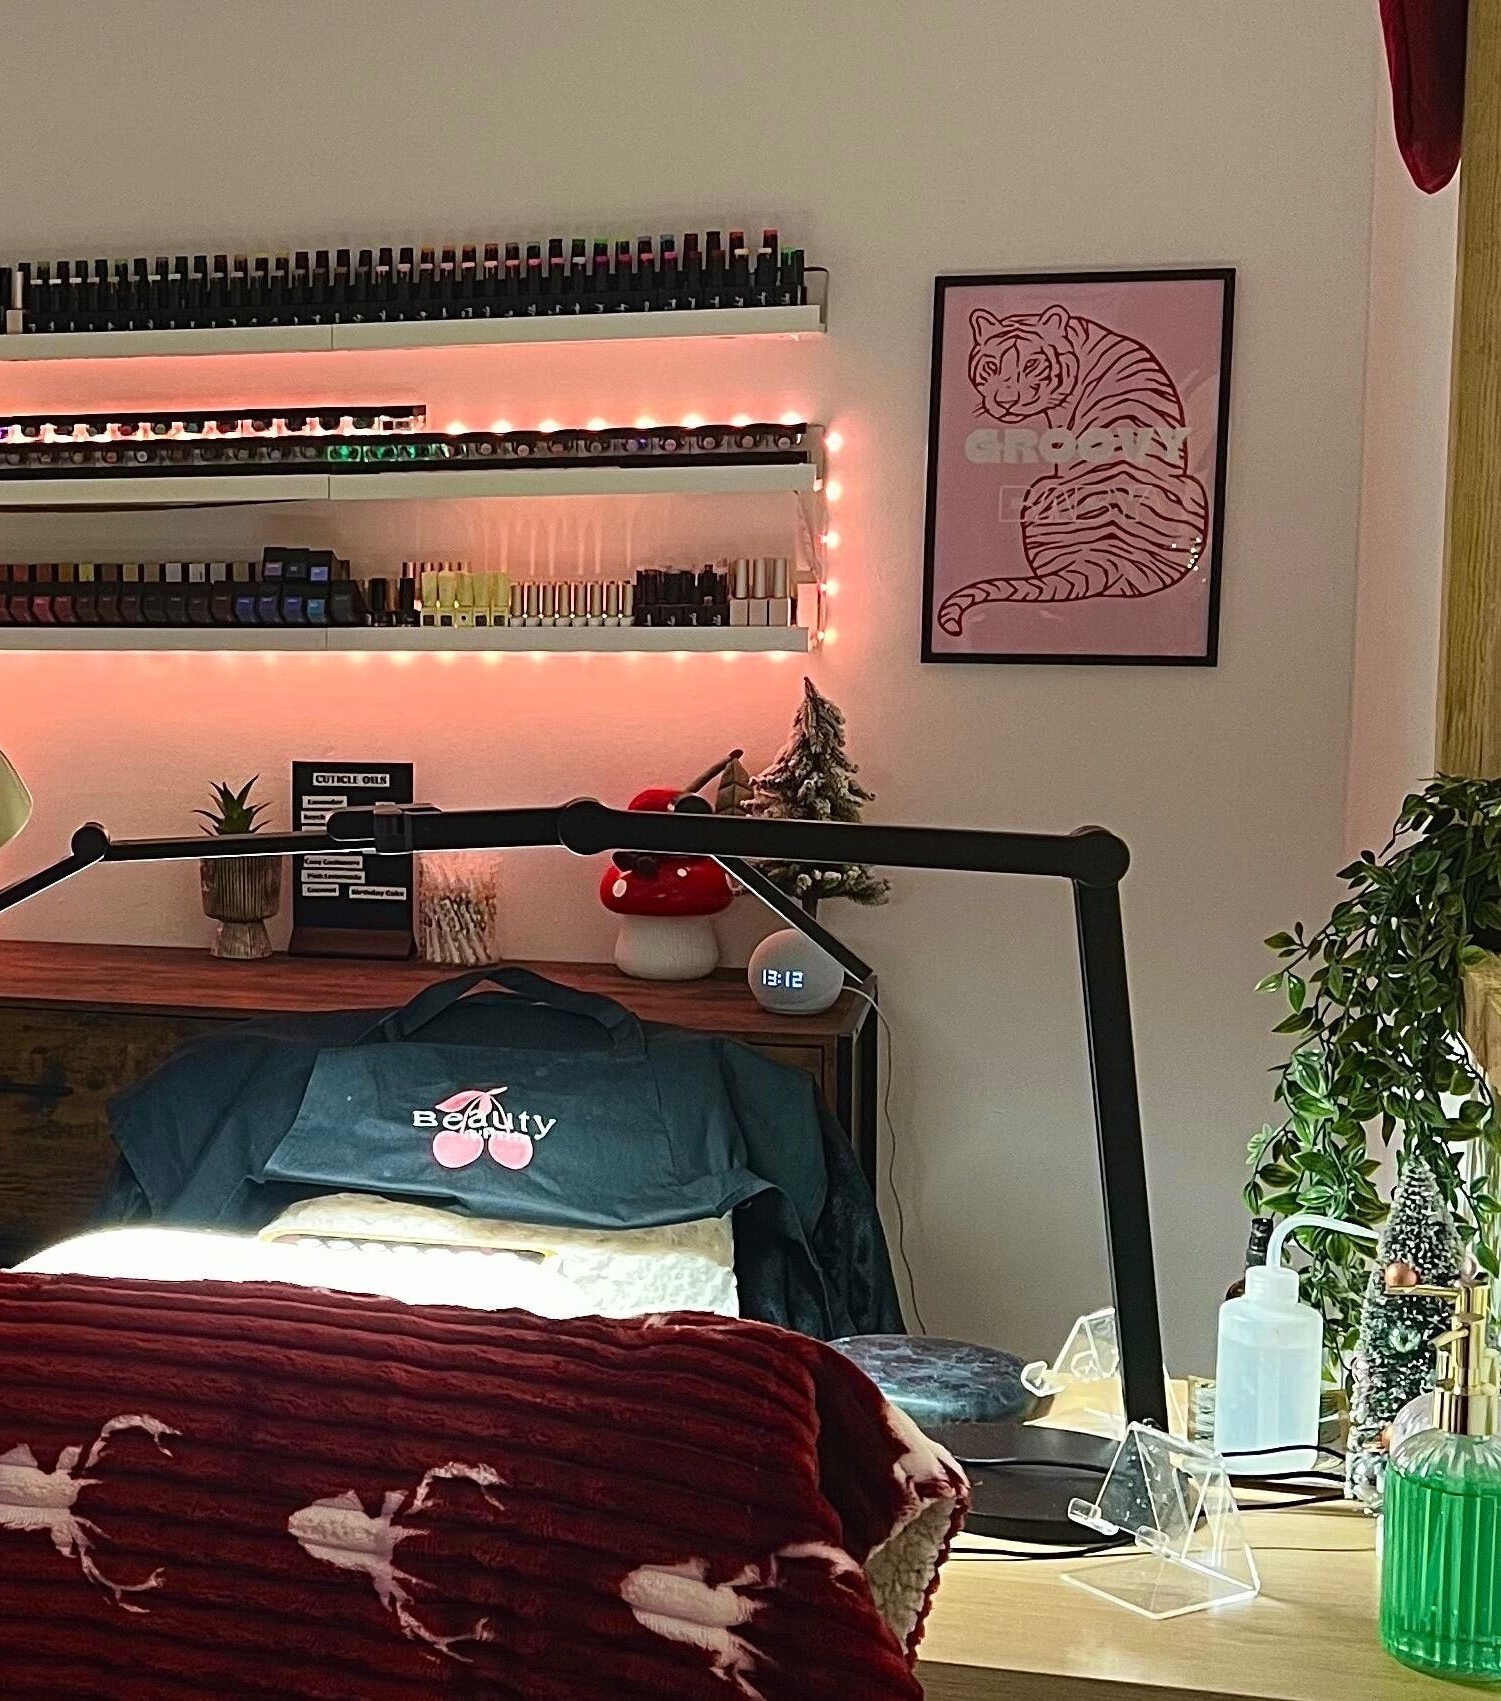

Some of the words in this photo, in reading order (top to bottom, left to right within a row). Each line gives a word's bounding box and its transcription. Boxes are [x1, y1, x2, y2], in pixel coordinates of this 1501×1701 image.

[964, 427, 1192, 464] GROOVY
[315, 775, 357, 785] CUTICLE
[362, 775, 387, 785] OILS
[762, 968, 804, 988] 13:12
[412, 1109, 558, 1141] Beauty
